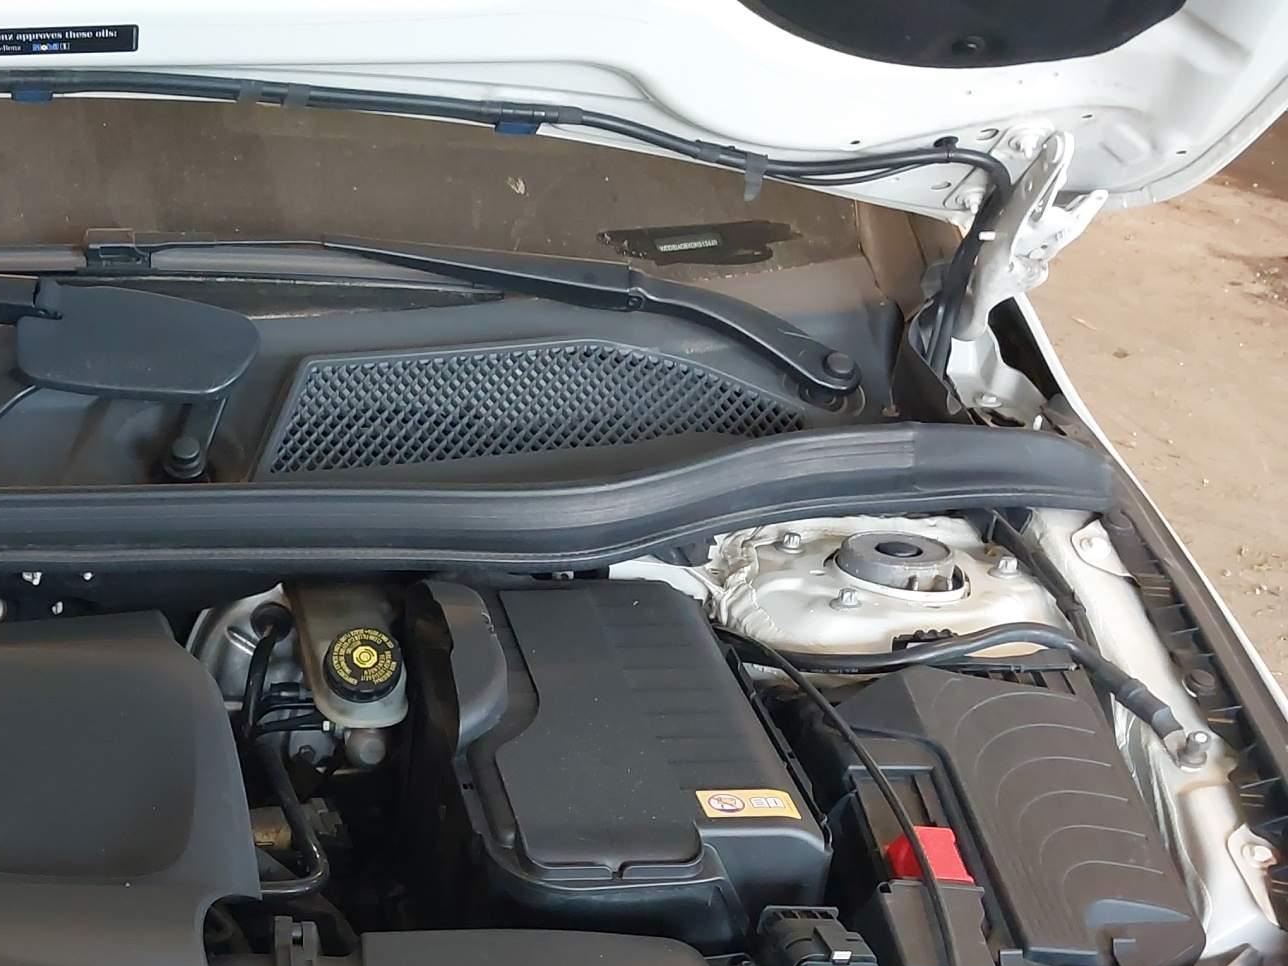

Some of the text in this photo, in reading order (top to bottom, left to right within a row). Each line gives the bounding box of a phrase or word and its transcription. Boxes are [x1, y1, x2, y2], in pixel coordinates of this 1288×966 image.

[16, 31, 63, 42] approves
[65, 30, 94, 39] these
[95, 28, 118, 38] oils:
